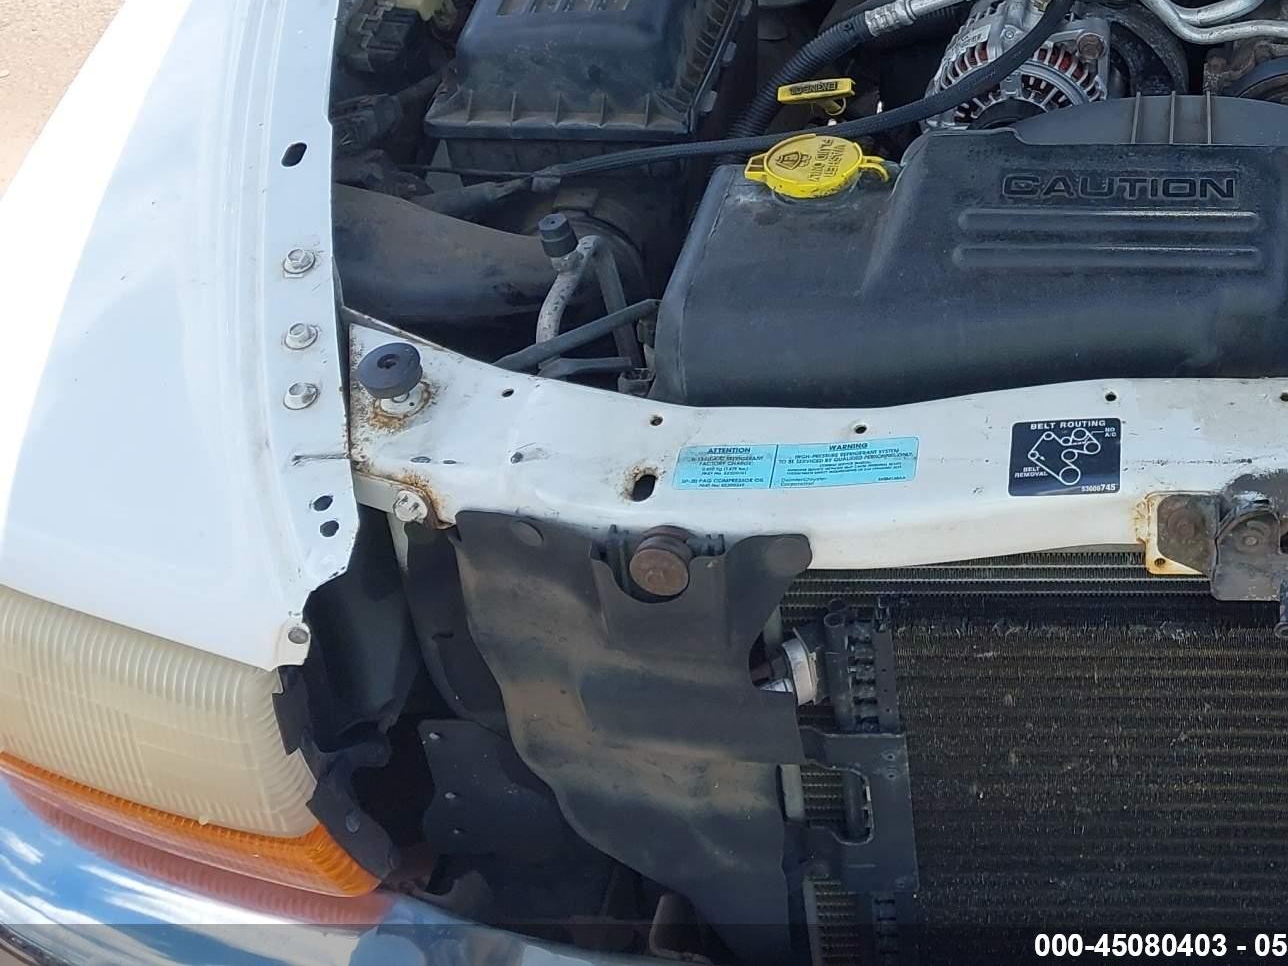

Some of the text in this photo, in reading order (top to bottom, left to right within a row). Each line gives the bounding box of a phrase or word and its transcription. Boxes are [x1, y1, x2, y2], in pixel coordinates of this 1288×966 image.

[1002, 172, 1236, 201] CAUTION
[1030, 420, 1106, 430] BELT ROUTING
[707, 446, 751, 455] ATTENTION
[829, 442, 869, 452] WARNING
[1014, 471, 1048, 479] REMOVAL
